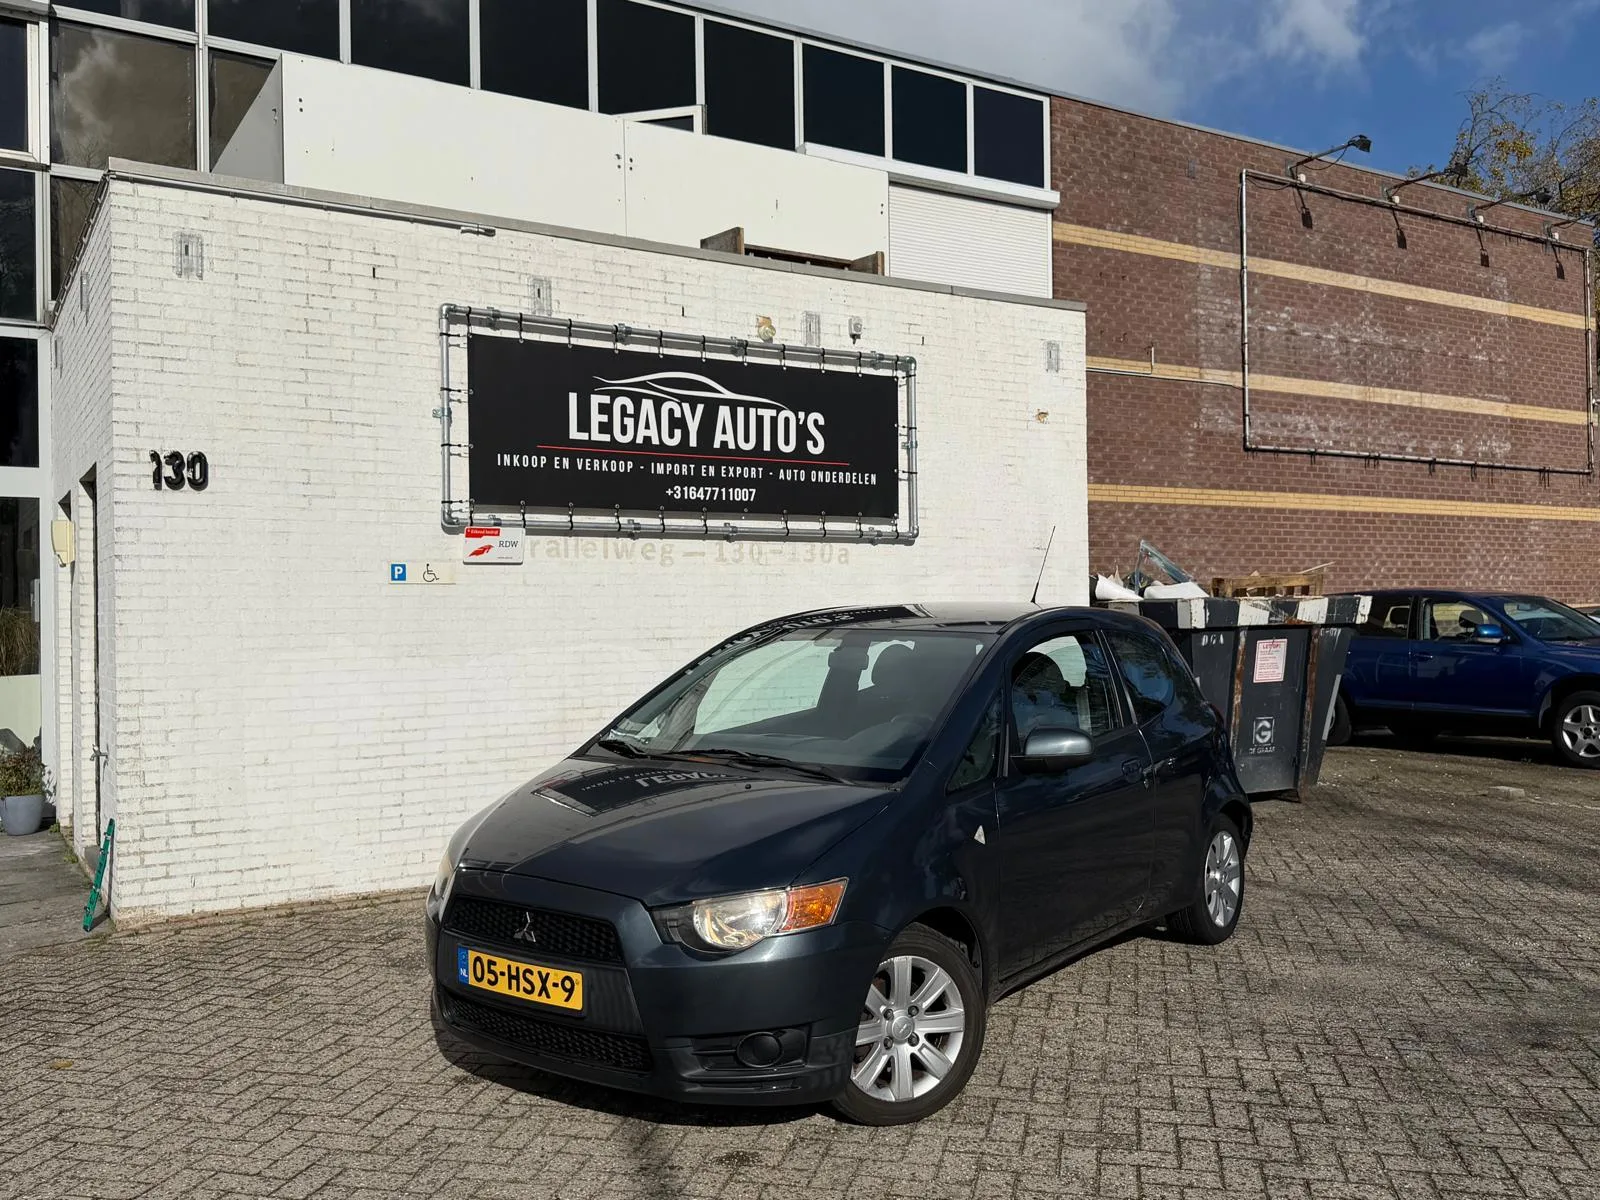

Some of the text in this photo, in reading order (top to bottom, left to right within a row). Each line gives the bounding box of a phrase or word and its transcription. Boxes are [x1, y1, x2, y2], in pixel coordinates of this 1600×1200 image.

[569, 391, 825, 455] LEGACY AUTO'S
[149, 450, 208, 491] 130
[497, 453, 548, 468] INKOOP
[554, 456, 570, 470] EN
[576, 457, 634, 473] VERKOOP
[651, 462, 696, 476] IMPORT
[701, 464, 715, 477] EN
[721, 465, 764, 480] EXPORT
[778, 468, 806, 482] AUTO
[810, 470, 877, 486] ONDERDELEN
[665, 485, 757, 502] +31647711007
[498, 540, 519, 548] RDW
[529, 537, 675, 568] rallelweg
[394, 565, 404, 579] P
[460, 955, 576, 1003] NL 05-HSX-9
